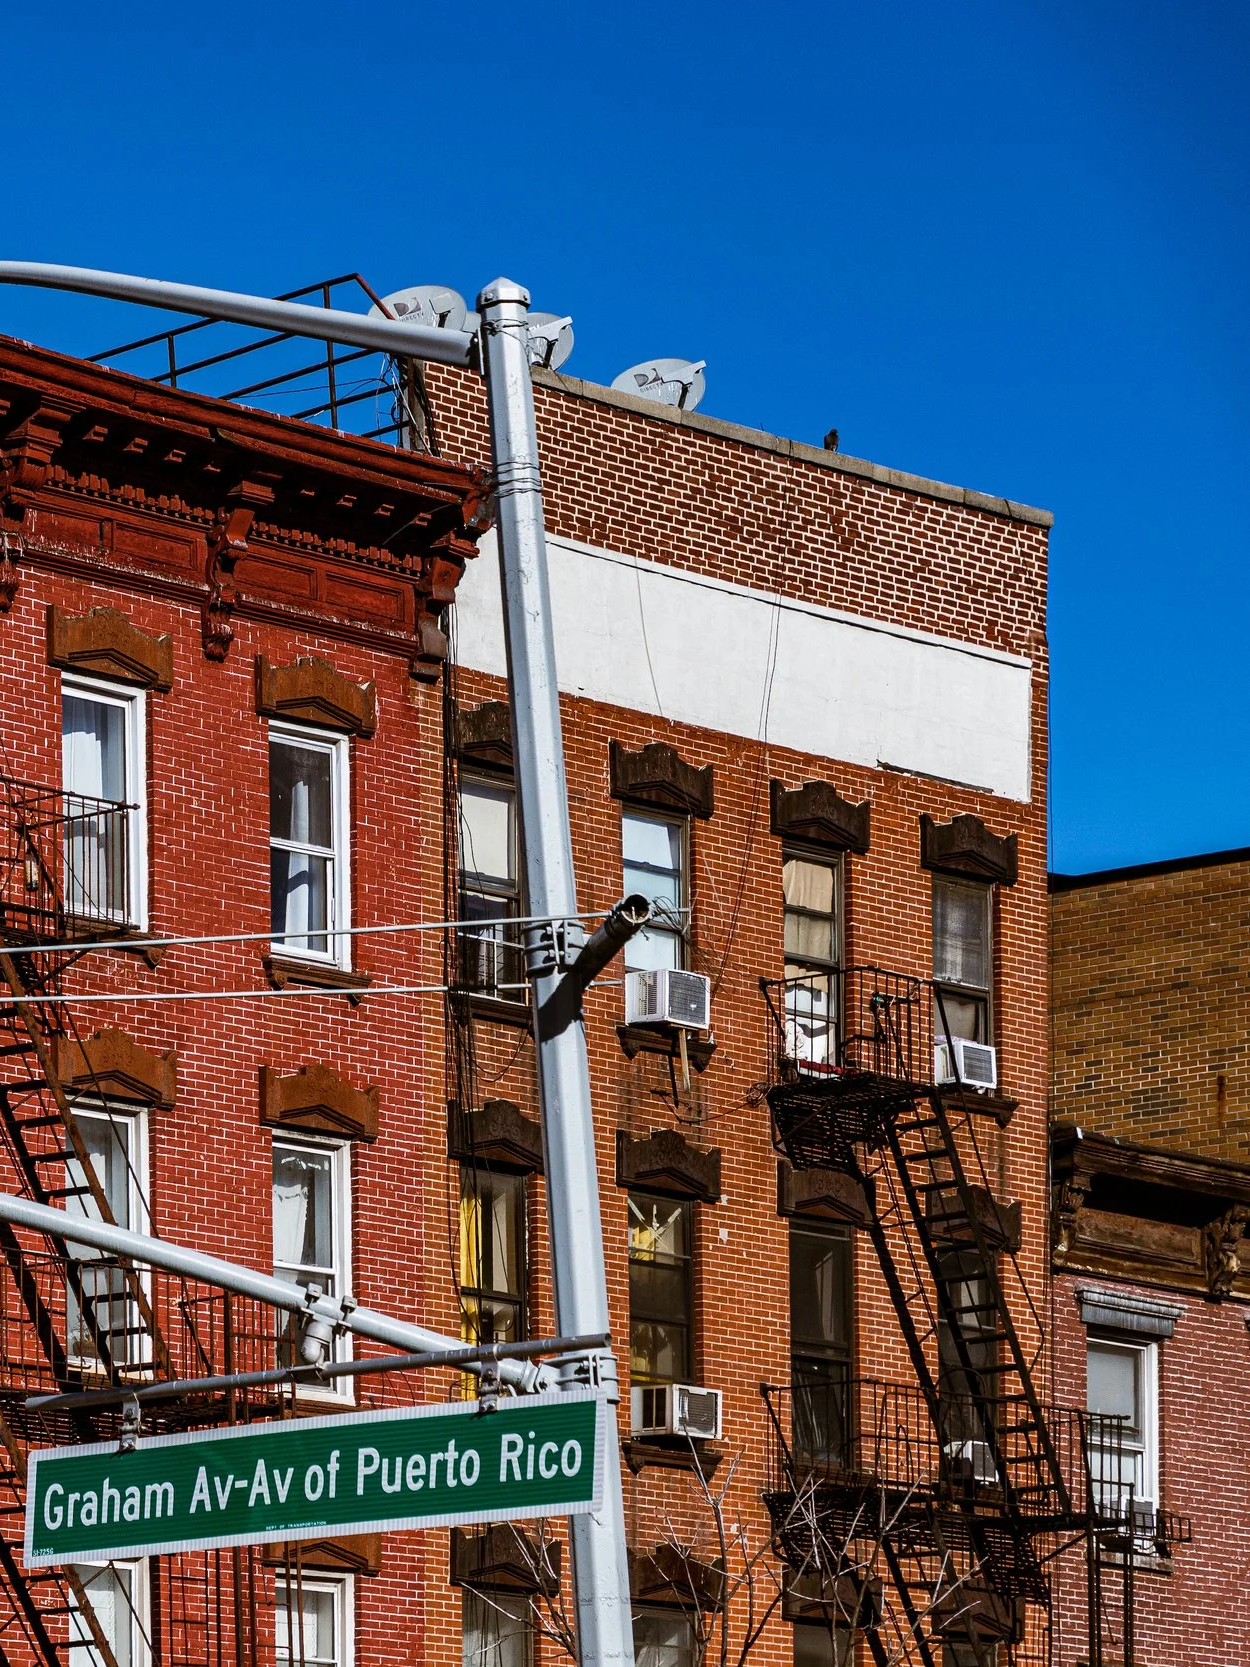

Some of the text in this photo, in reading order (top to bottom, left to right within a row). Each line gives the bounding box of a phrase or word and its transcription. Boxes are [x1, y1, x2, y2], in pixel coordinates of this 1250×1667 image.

[43, 1430, 582, 1531] Graham Av-Av of Puerto Rico
